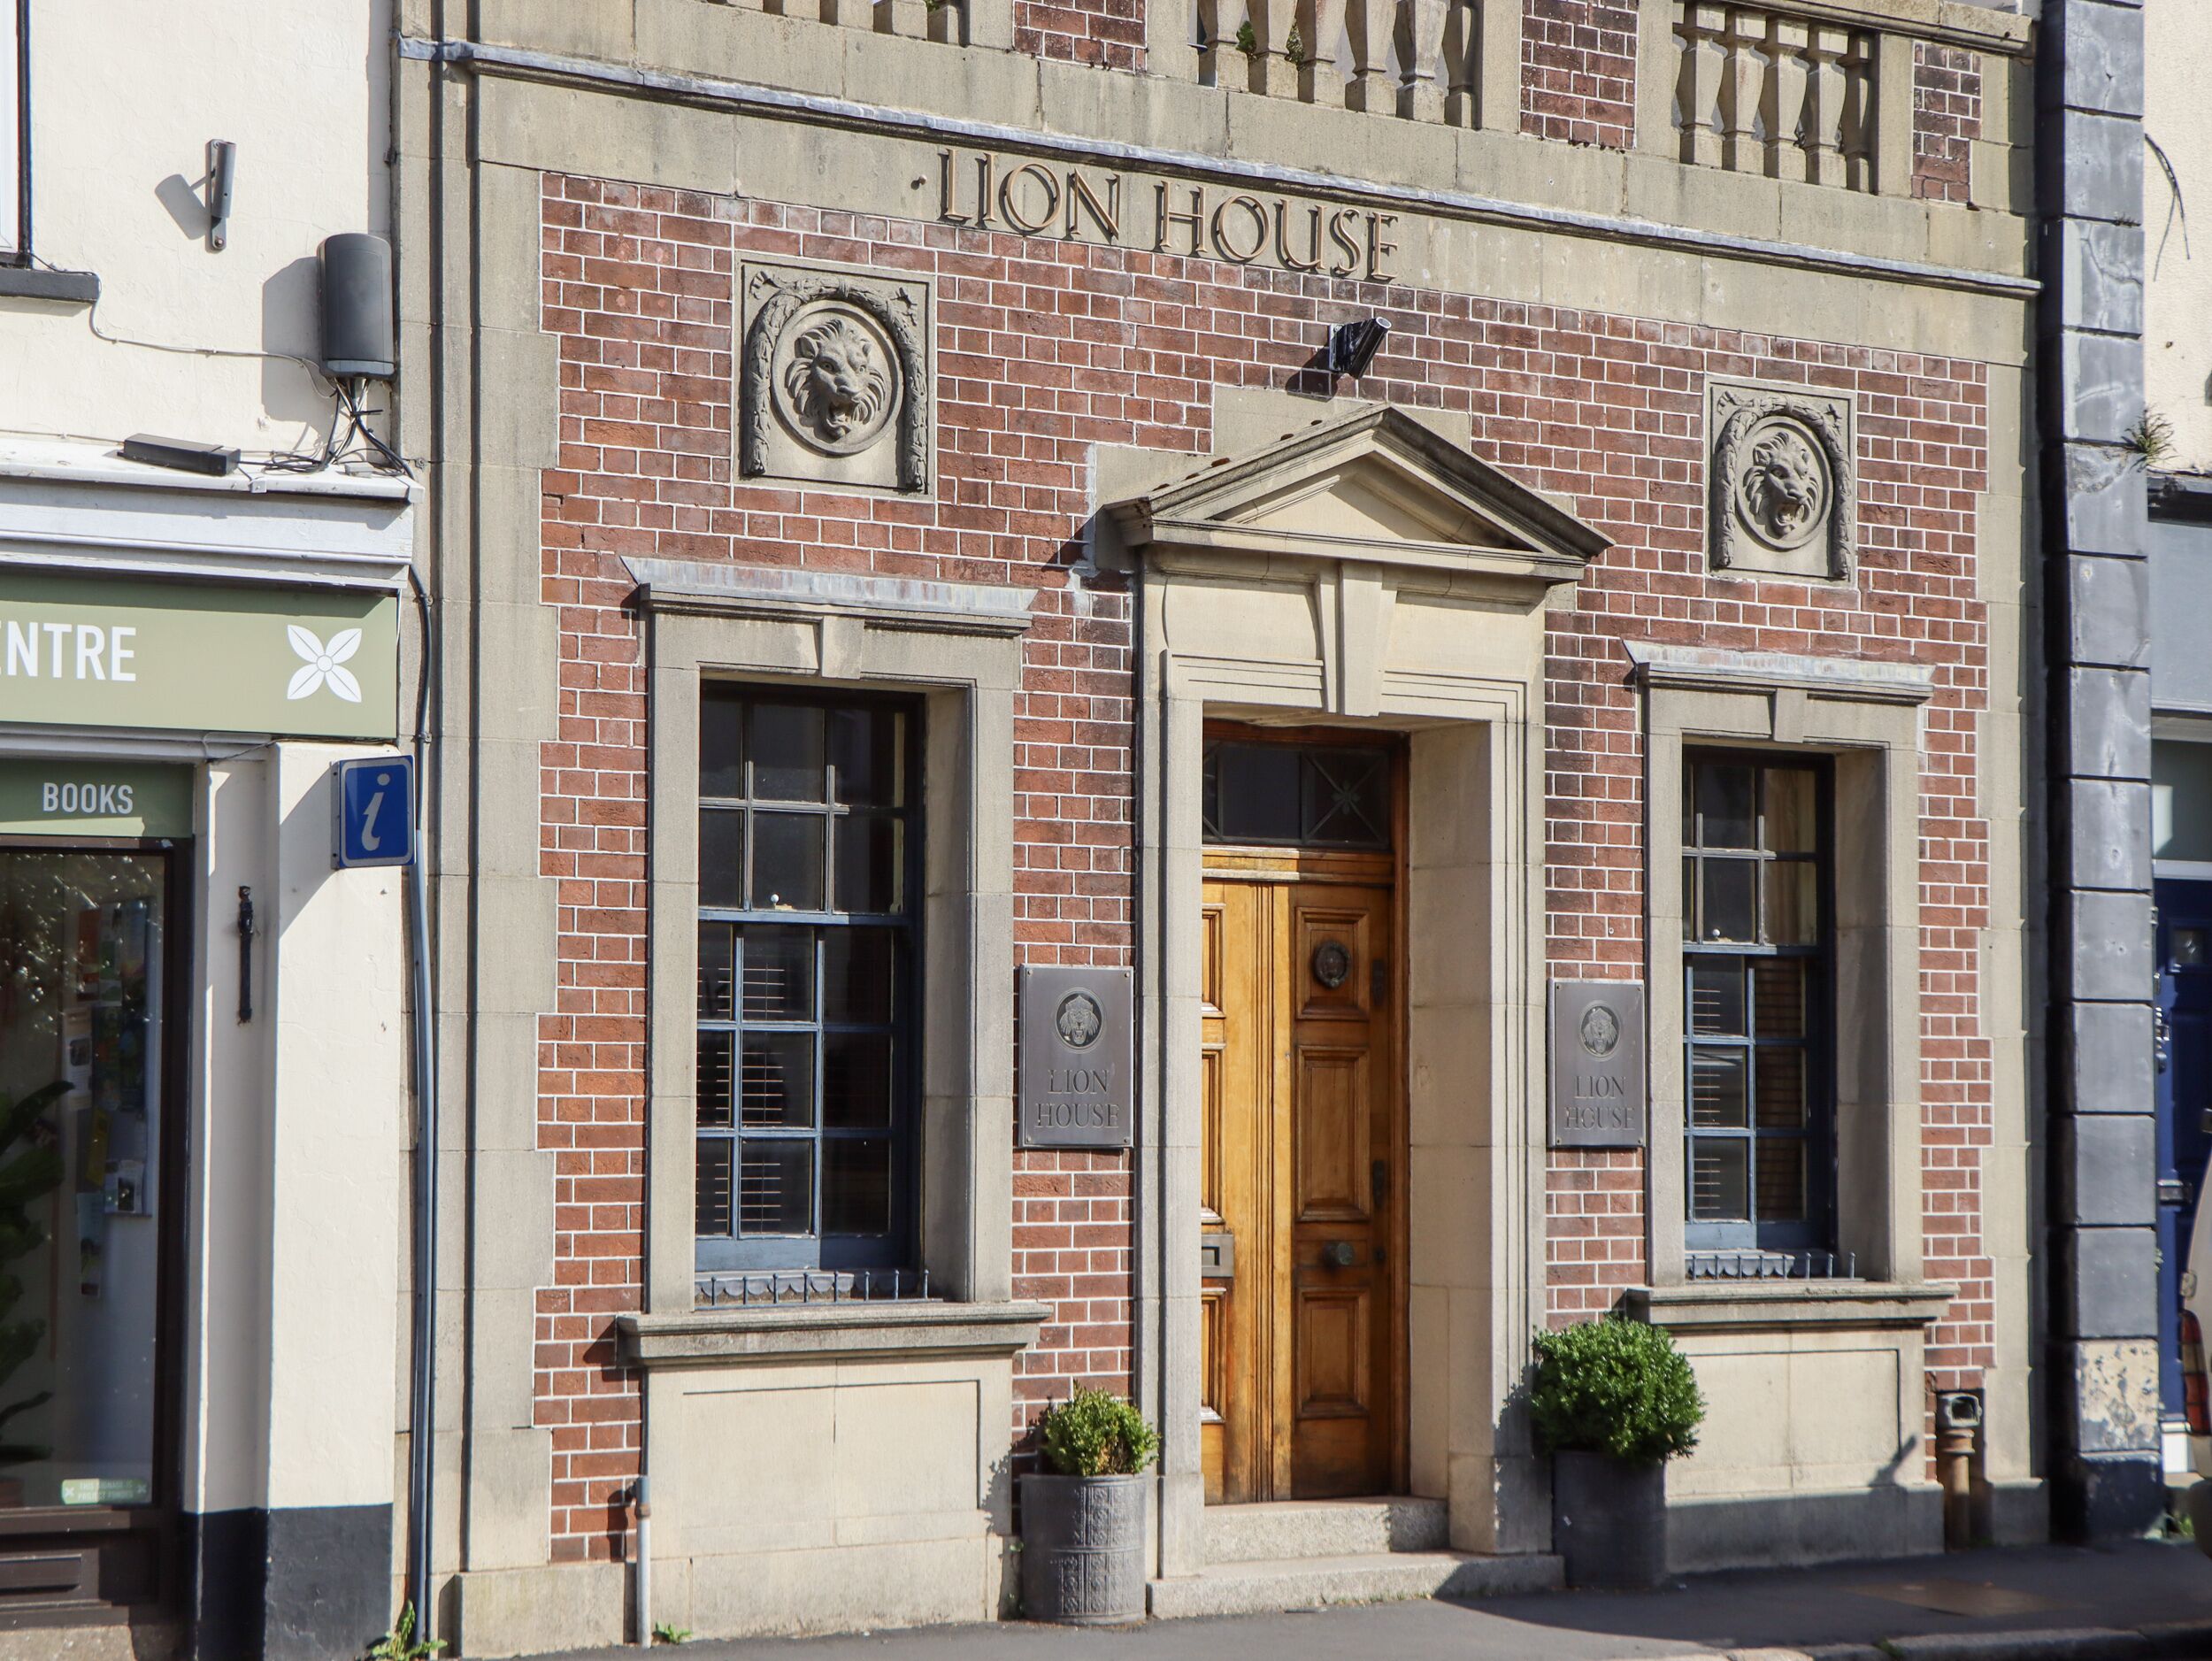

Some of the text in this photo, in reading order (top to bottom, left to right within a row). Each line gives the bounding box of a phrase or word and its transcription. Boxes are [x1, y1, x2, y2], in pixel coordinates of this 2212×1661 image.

[944, 148, 1399, 280] LION HOUSE
[0, 619, 136, 681] NTRE
[42, 782, 134, 814] BOOKS
[1047, 1069, 1110, 1095] LION
[1574, 1075, 1626, 1099] LION
[1033, 1103, 1120, 1129] HOUSE
[1563, 1106, 1635, 1131] HOUSE
